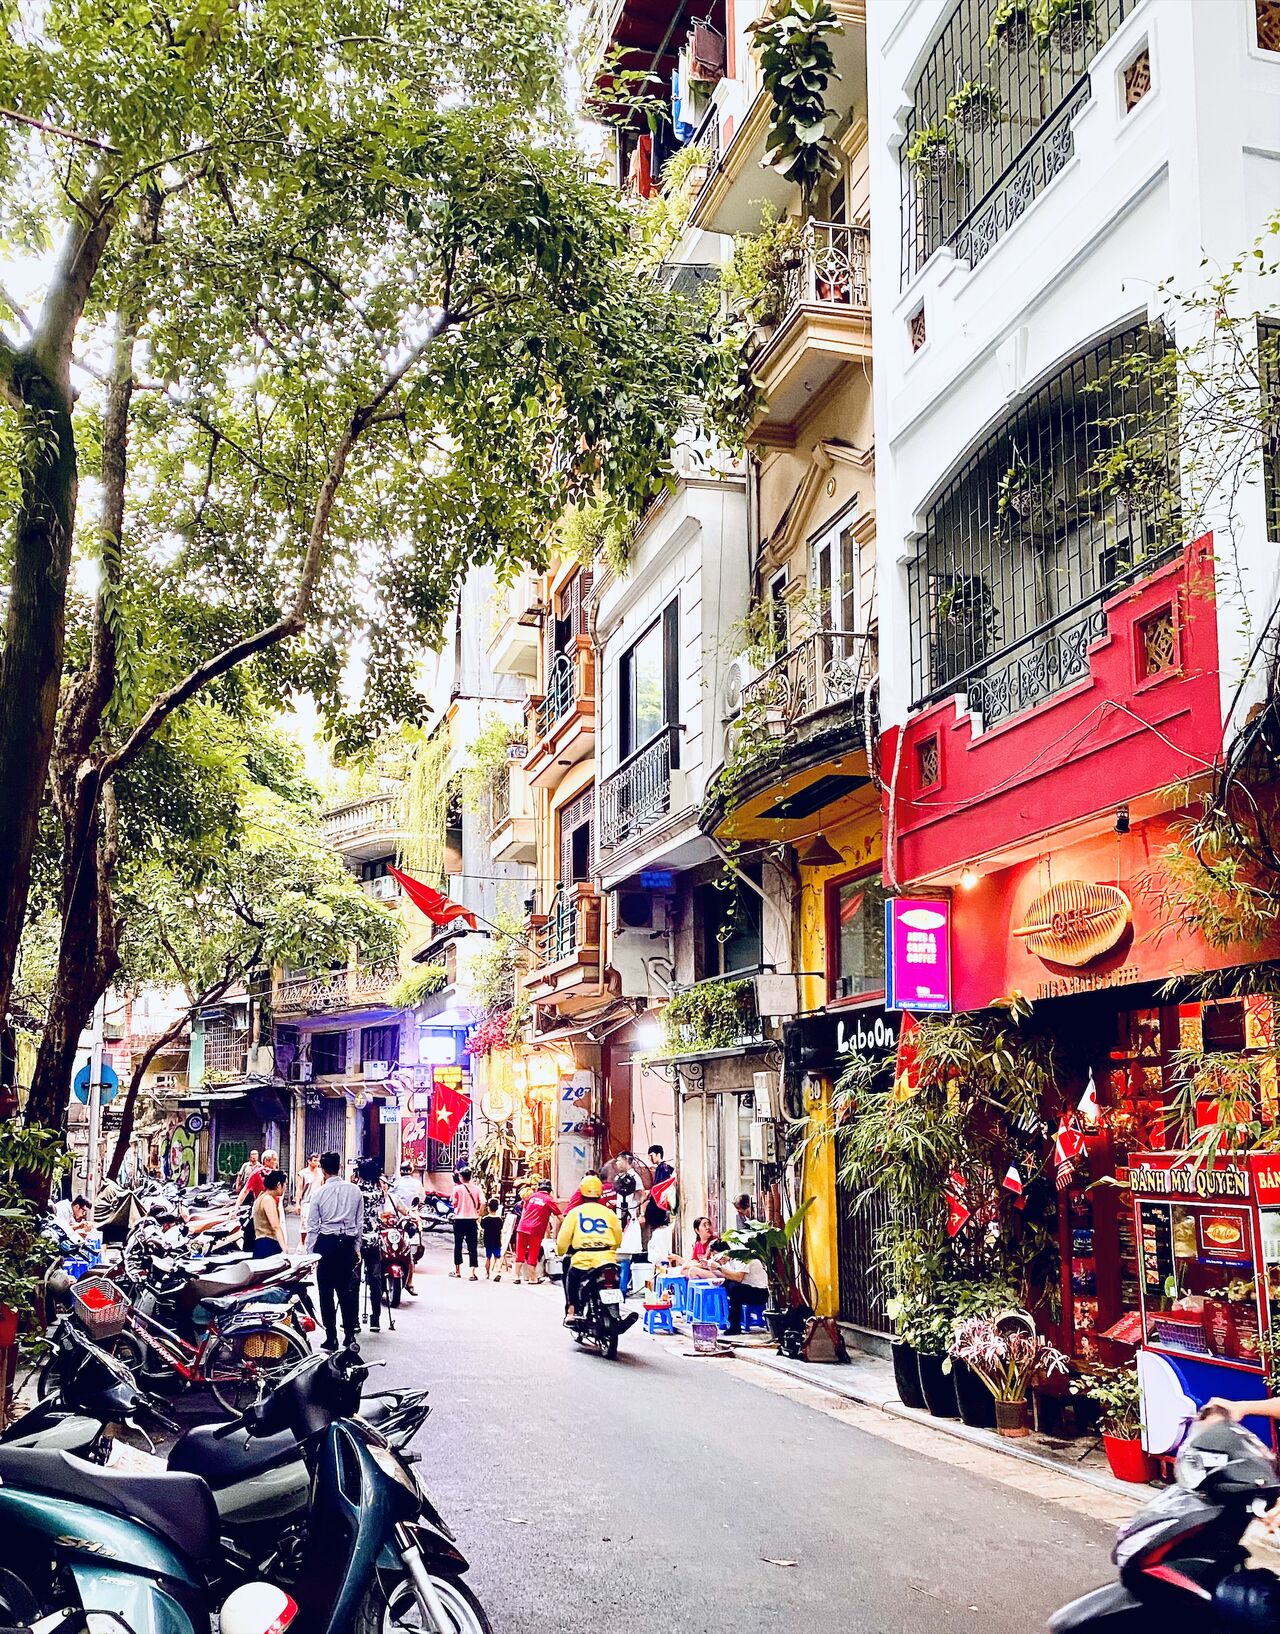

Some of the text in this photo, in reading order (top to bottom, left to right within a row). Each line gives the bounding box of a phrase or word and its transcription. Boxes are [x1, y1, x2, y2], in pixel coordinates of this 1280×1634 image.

[906, 953, 937, 964] COFFEE
[1130, 1164, 1166, 1193] BÁNH
[579, 1212, 608, 1234] be
